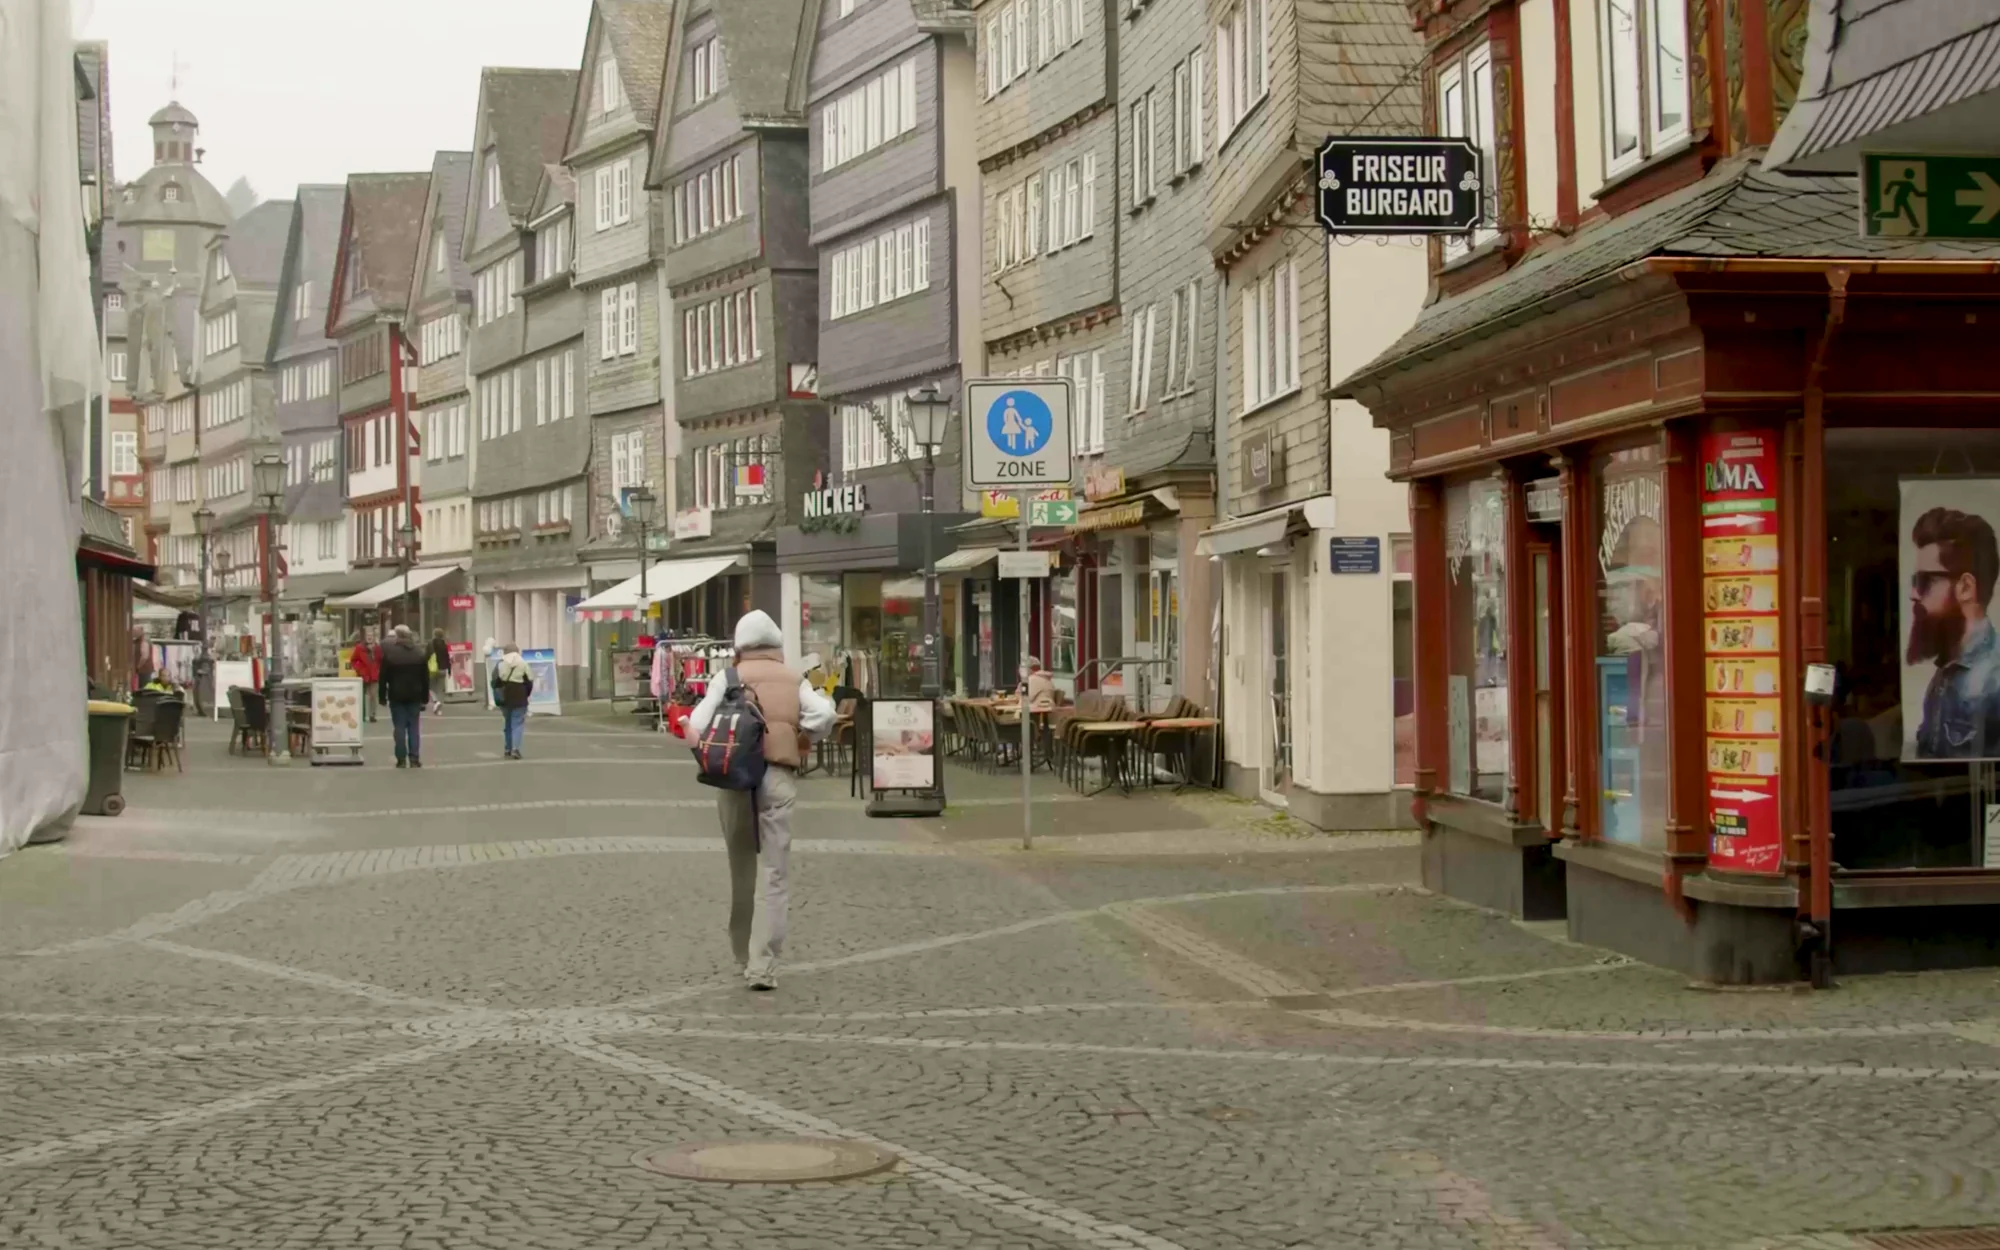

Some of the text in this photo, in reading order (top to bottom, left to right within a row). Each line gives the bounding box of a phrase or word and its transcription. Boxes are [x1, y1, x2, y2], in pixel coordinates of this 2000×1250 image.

[1352, 155, 1446, 182] FRISEUR
[1346, 188, 1453, 216] BURGARD
[996, 461, 1046, 477] ZONE
[803, 484, 865, 517] NICKEL
